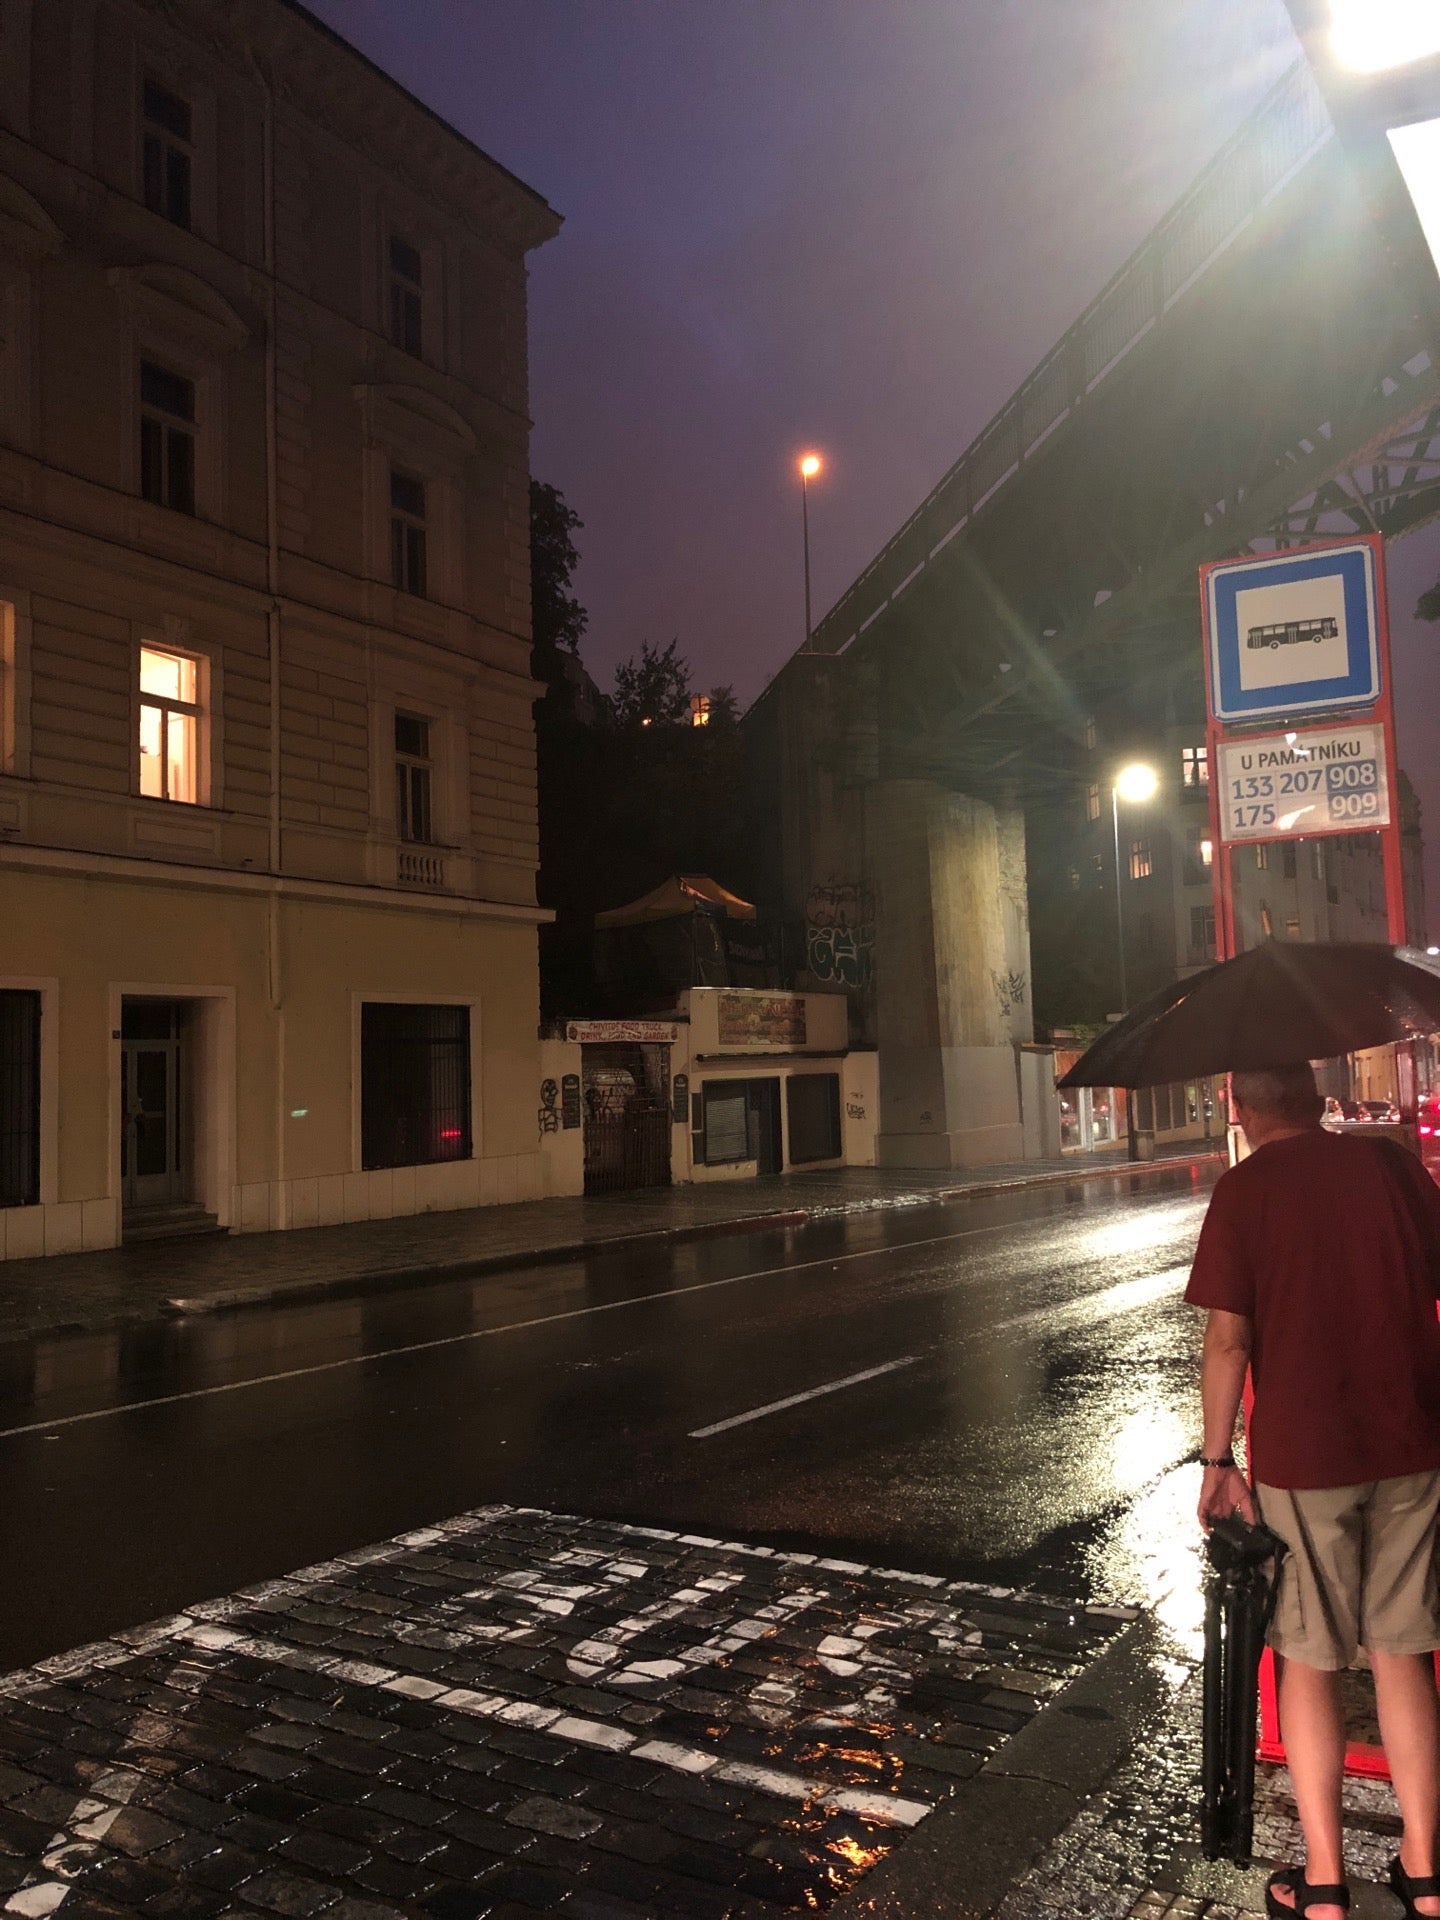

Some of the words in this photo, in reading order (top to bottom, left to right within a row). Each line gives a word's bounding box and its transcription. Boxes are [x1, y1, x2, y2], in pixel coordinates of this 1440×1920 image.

[1241, 755, 1252, 770] U
[1259, 741, 1361, 768] PAMÁTNÍKU
[1232, 775, 1274, 800] 133
[1280, 769, 1323, 794] 207
[1329, 763, 1375, 788] 908
[1234, 803, 1276, 828] 175
[1331, 792, 1377, 817] 909
[622, 1022, 639, 1031] FOOD
[643, 1031, 669, 1041] GARDEN
